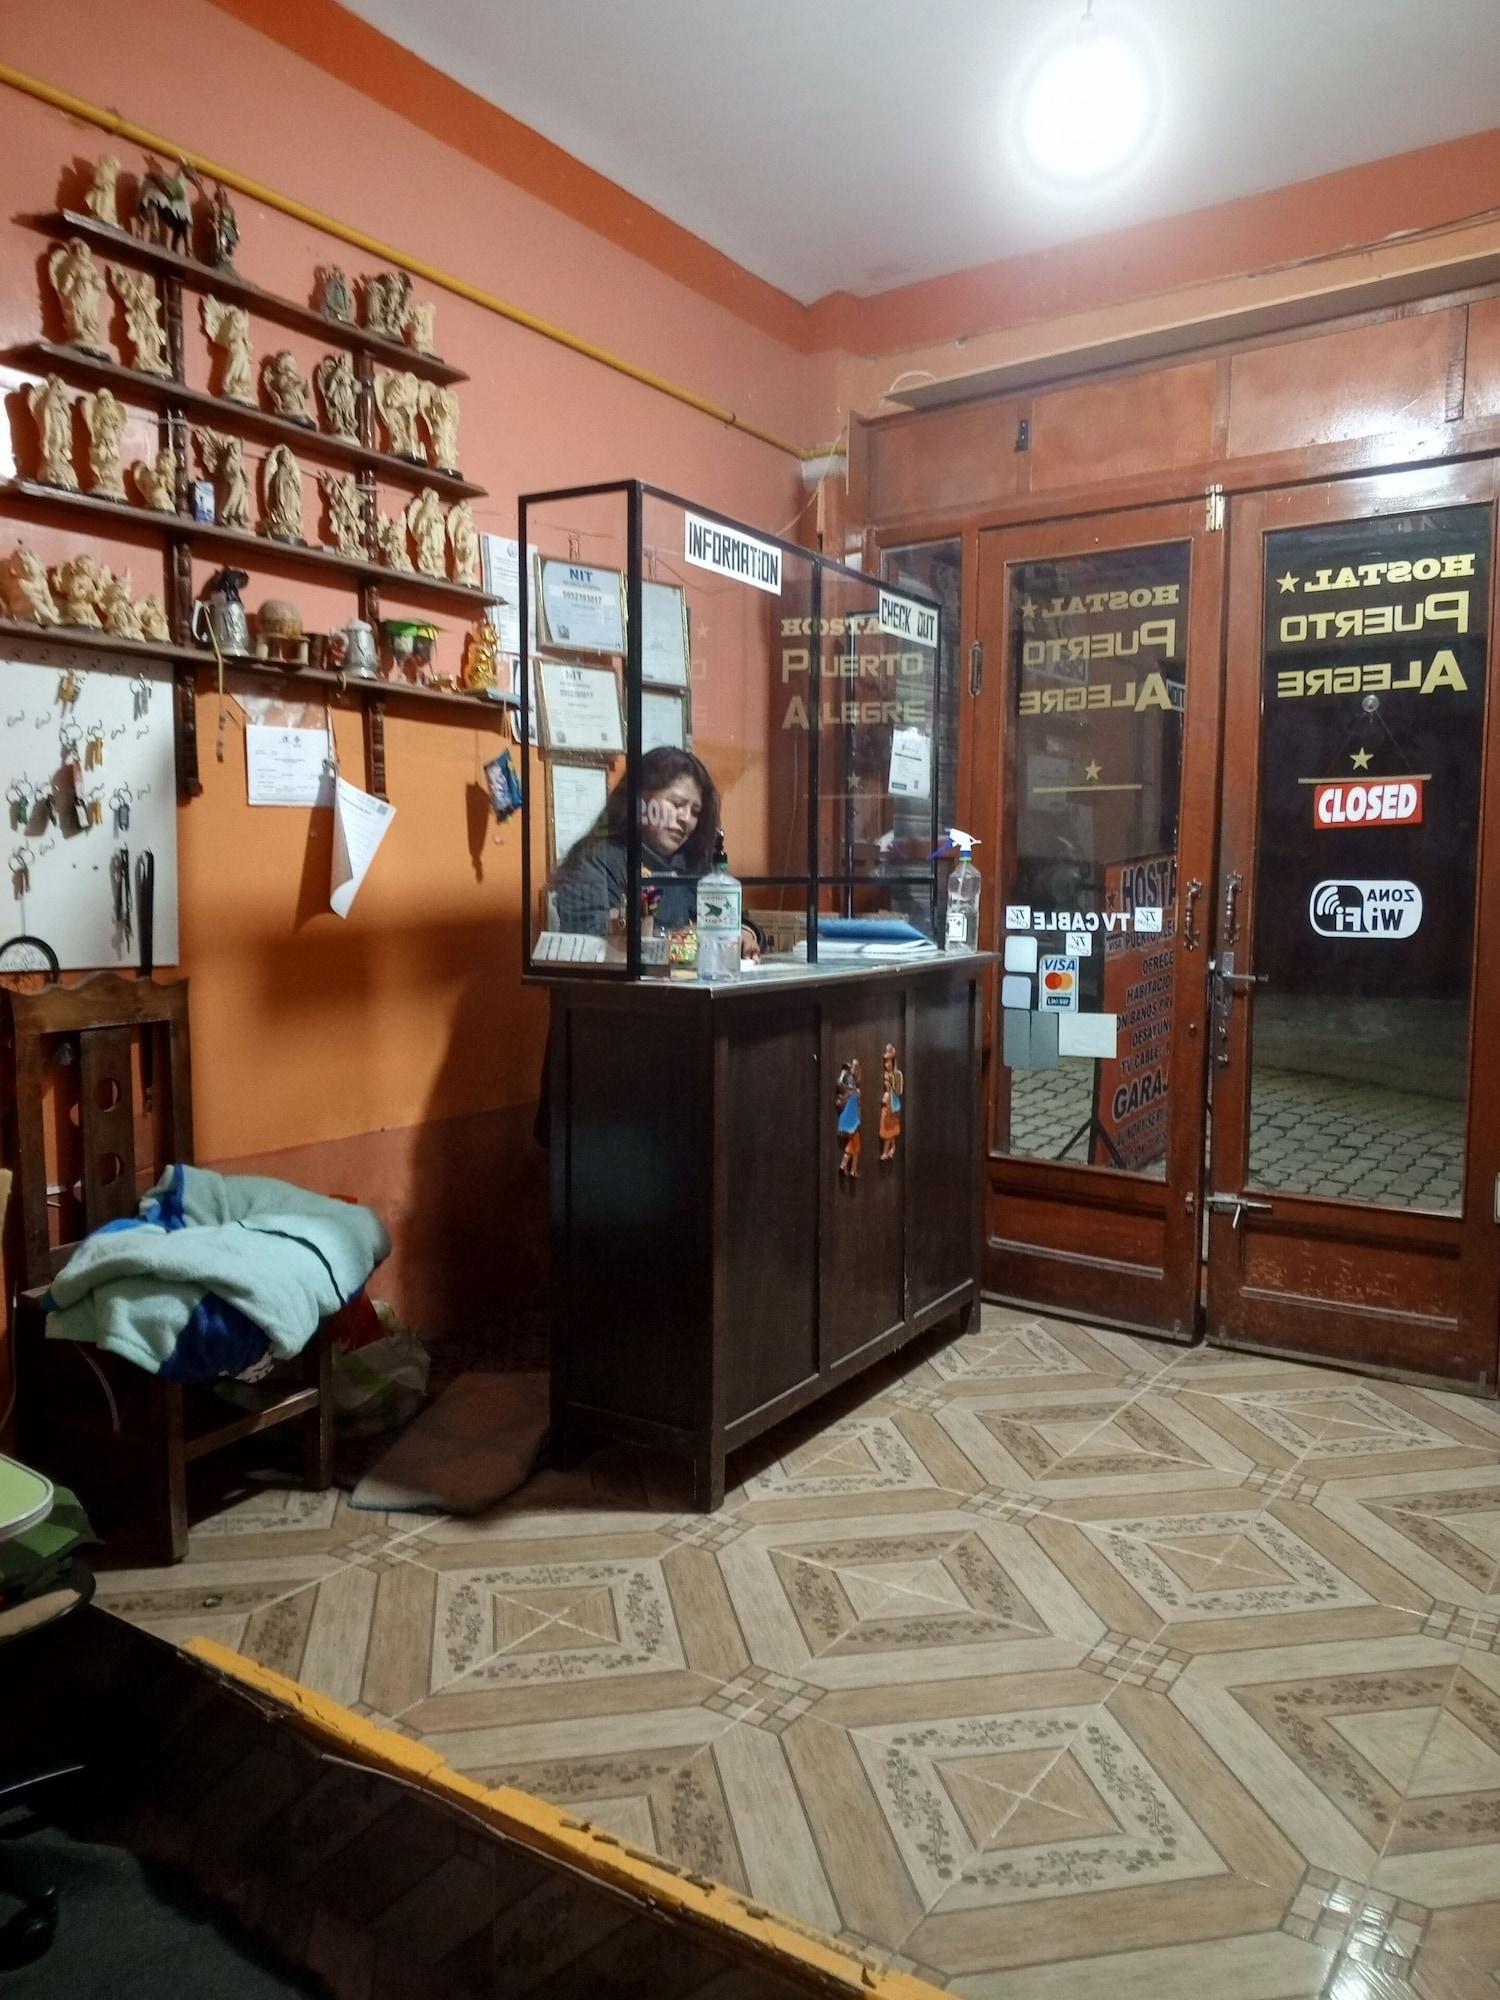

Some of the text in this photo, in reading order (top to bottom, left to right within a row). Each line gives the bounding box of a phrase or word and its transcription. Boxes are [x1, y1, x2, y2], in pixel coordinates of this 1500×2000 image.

[688, 521, 779, 587] INFORMATION
[569, 567, 593, 583] NIT
[881, 597, 935, 641] CHECK OUT
[1317, 783, 1418, 824] CLOSED
[1044, 959, 1076, 971] VISA
[1127, 974, 1173, 1004] HABITACIO
